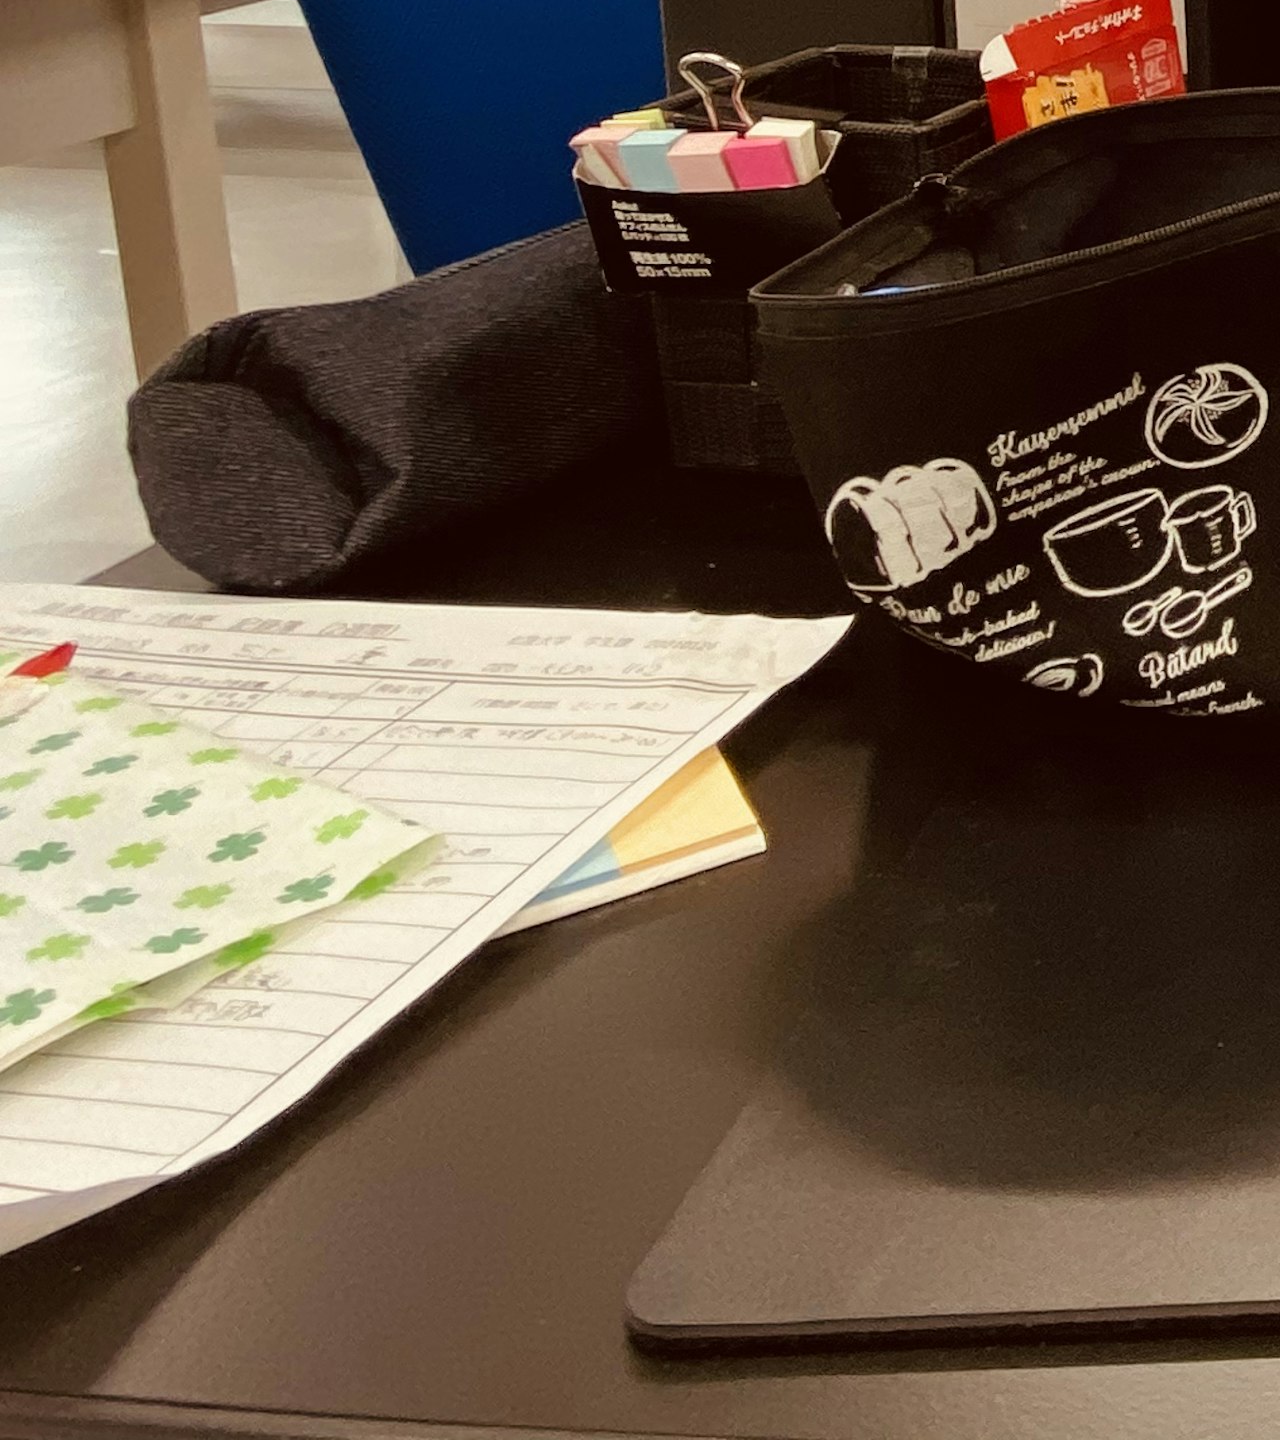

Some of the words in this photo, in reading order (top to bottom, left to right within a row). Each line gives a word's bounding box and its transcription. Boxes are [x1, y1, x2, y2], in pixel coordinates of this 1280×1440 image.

[1002, 479, 1053, 507] shape
[1058, 464, 1079, 484] of
[1079, 456, 1108, 476] the
[1048, 452, 1077, 470] the
[948, 582, 980, 615] de
[986, 564, 1030, 594] mie
